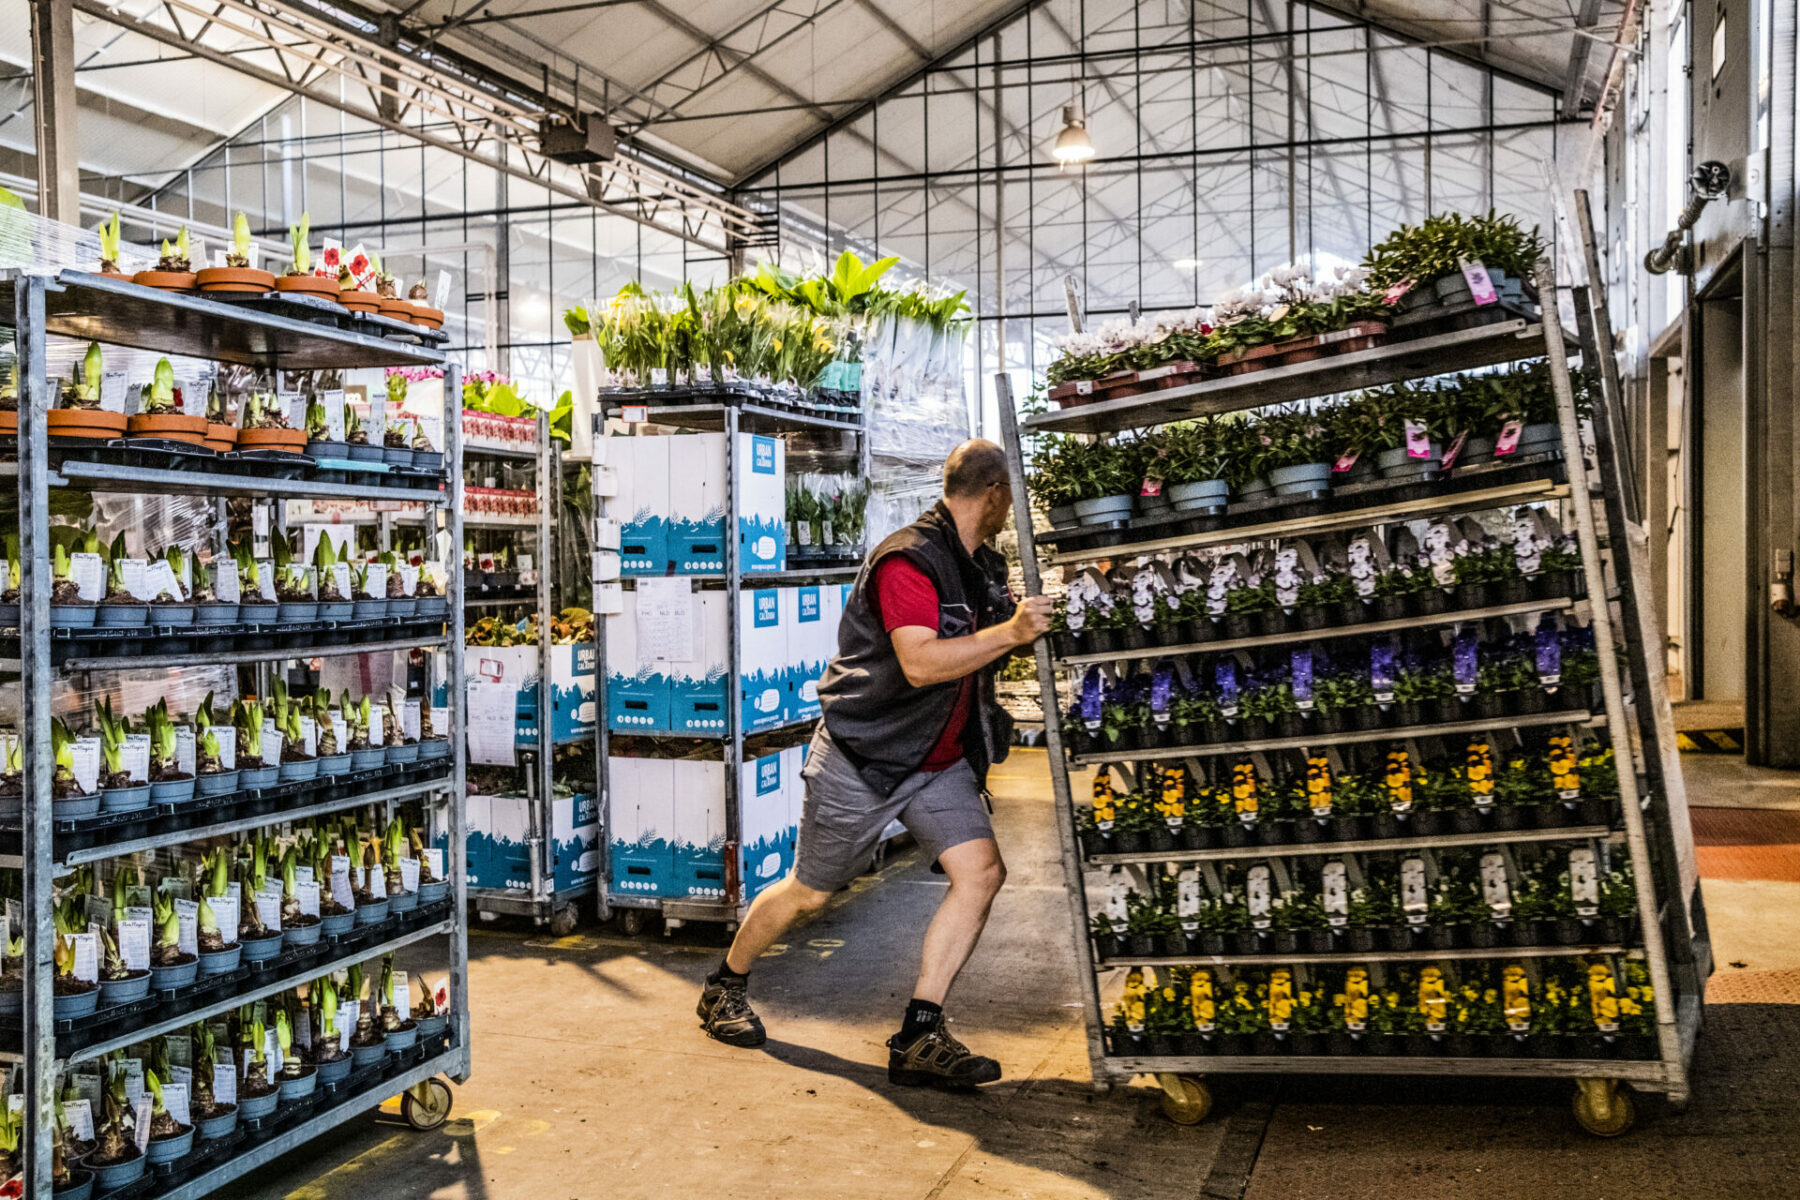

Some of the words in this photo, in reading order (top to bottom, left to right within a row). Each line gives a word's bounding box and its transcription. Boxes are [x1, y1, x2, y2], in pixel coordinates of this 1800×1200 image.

[756, 442, 772, 457] URBAN
[758, 596, 775, 610] URBAN
[801, 594, 817, 606] URBAN
[761, 762, 777, 777] URBAN
